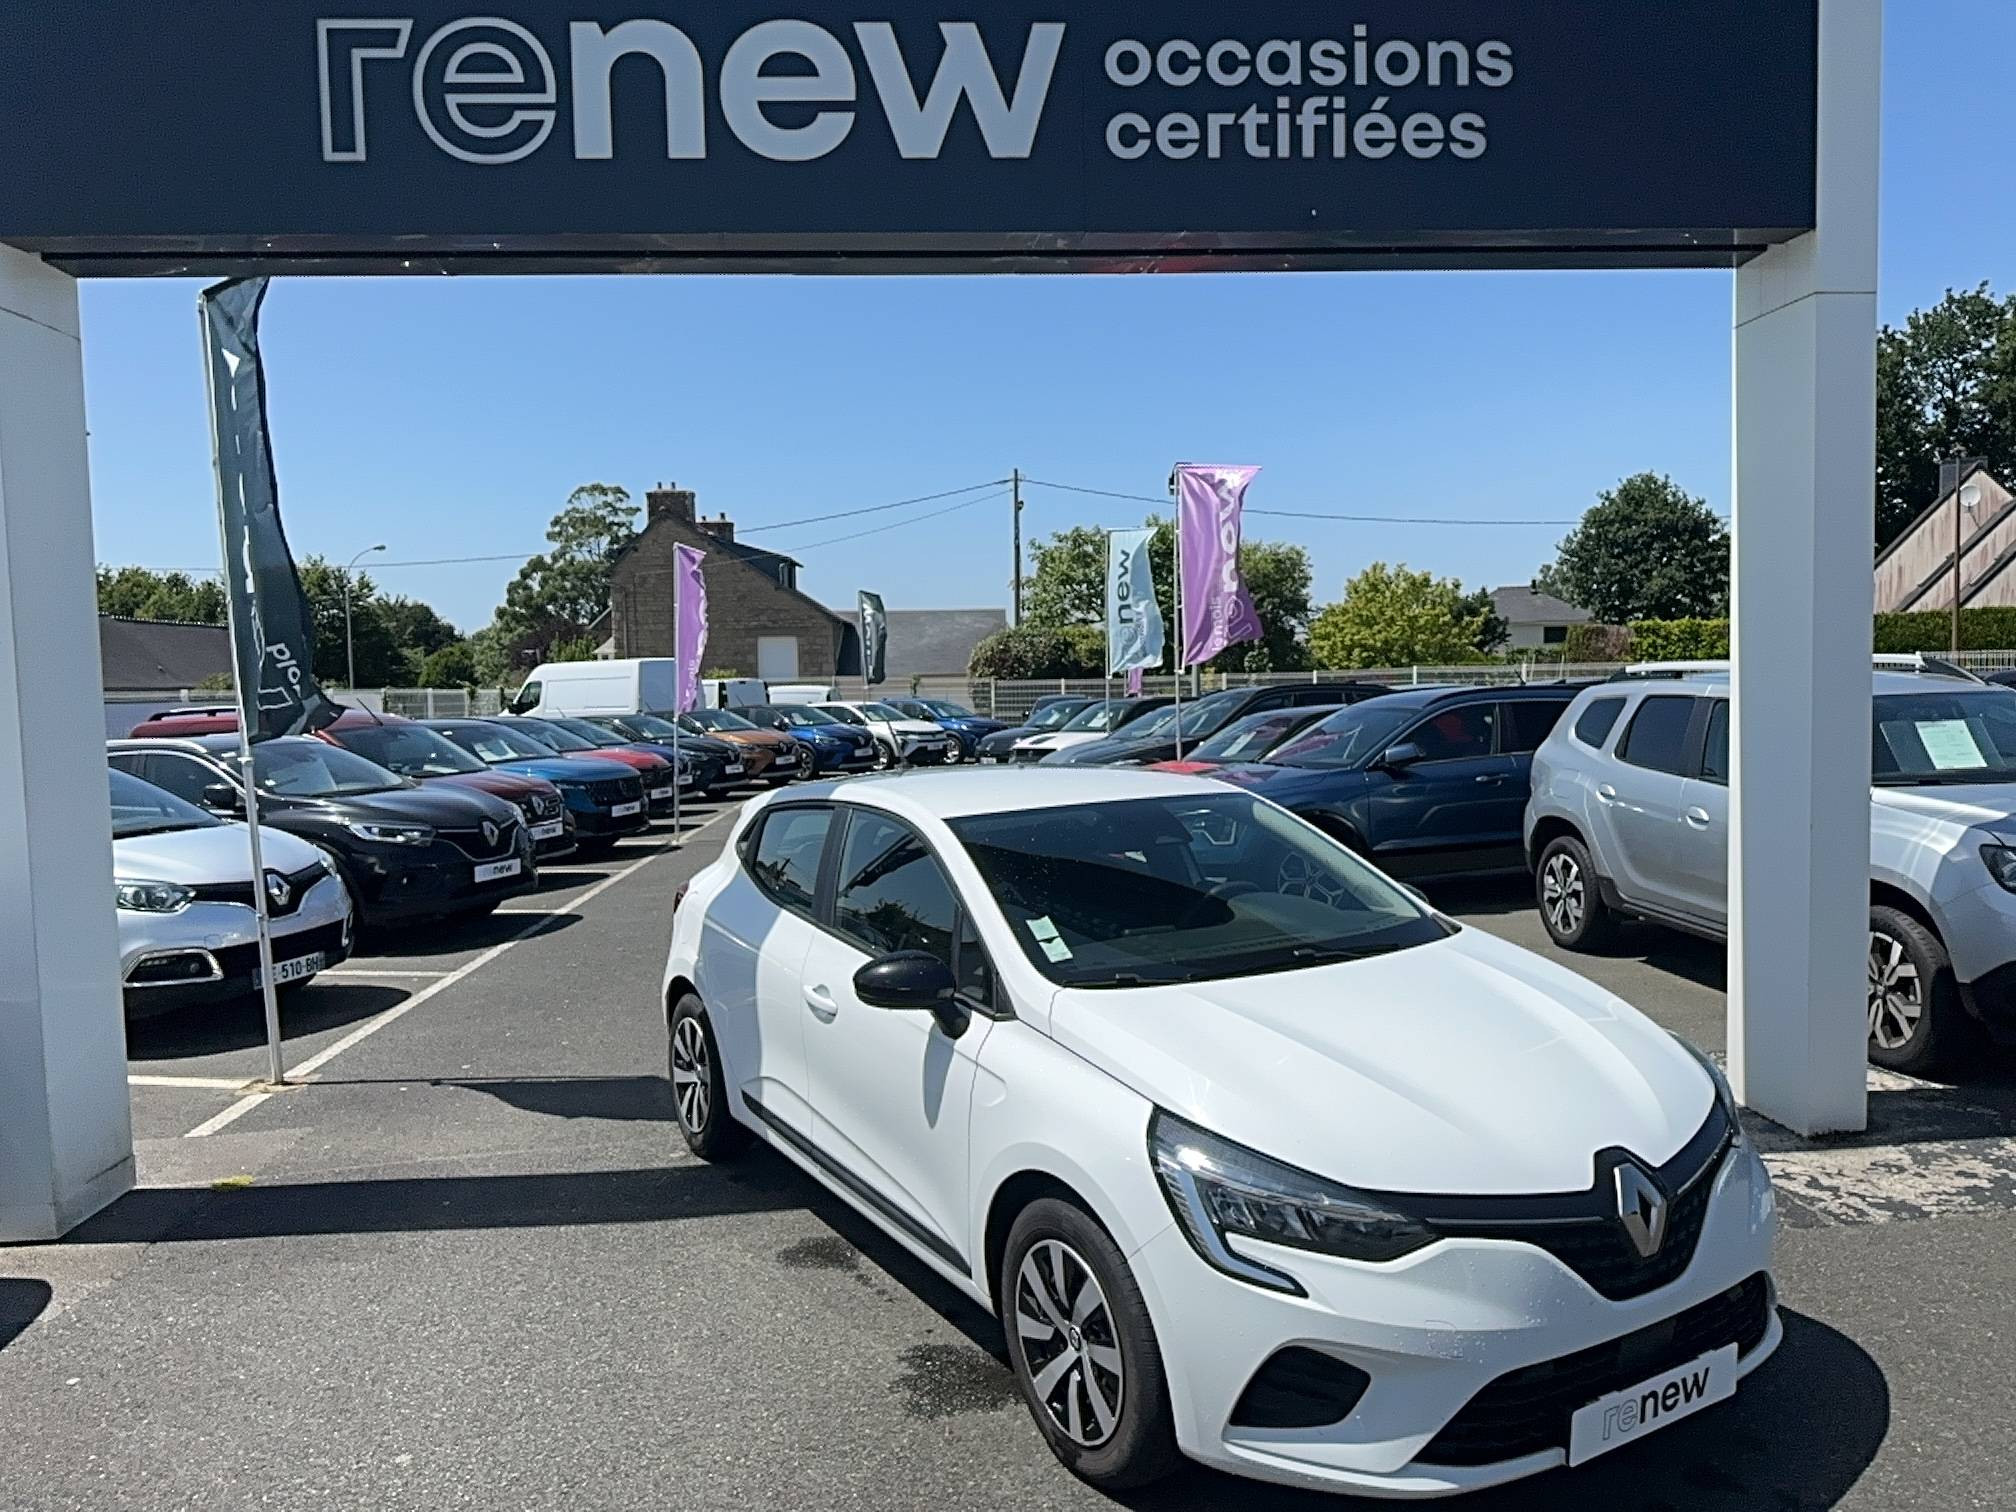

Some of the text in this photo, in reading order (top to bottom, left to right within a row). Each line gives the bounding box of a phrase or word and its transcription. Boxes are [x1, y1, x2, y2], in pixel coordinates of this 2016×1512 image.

[1104, 24, 1514, 86] occasions
[317, 17, 1067, 164] renew
[1106, 96, 1487, 159] certifiées
[1602, 1366, 1711, 1440] renew
